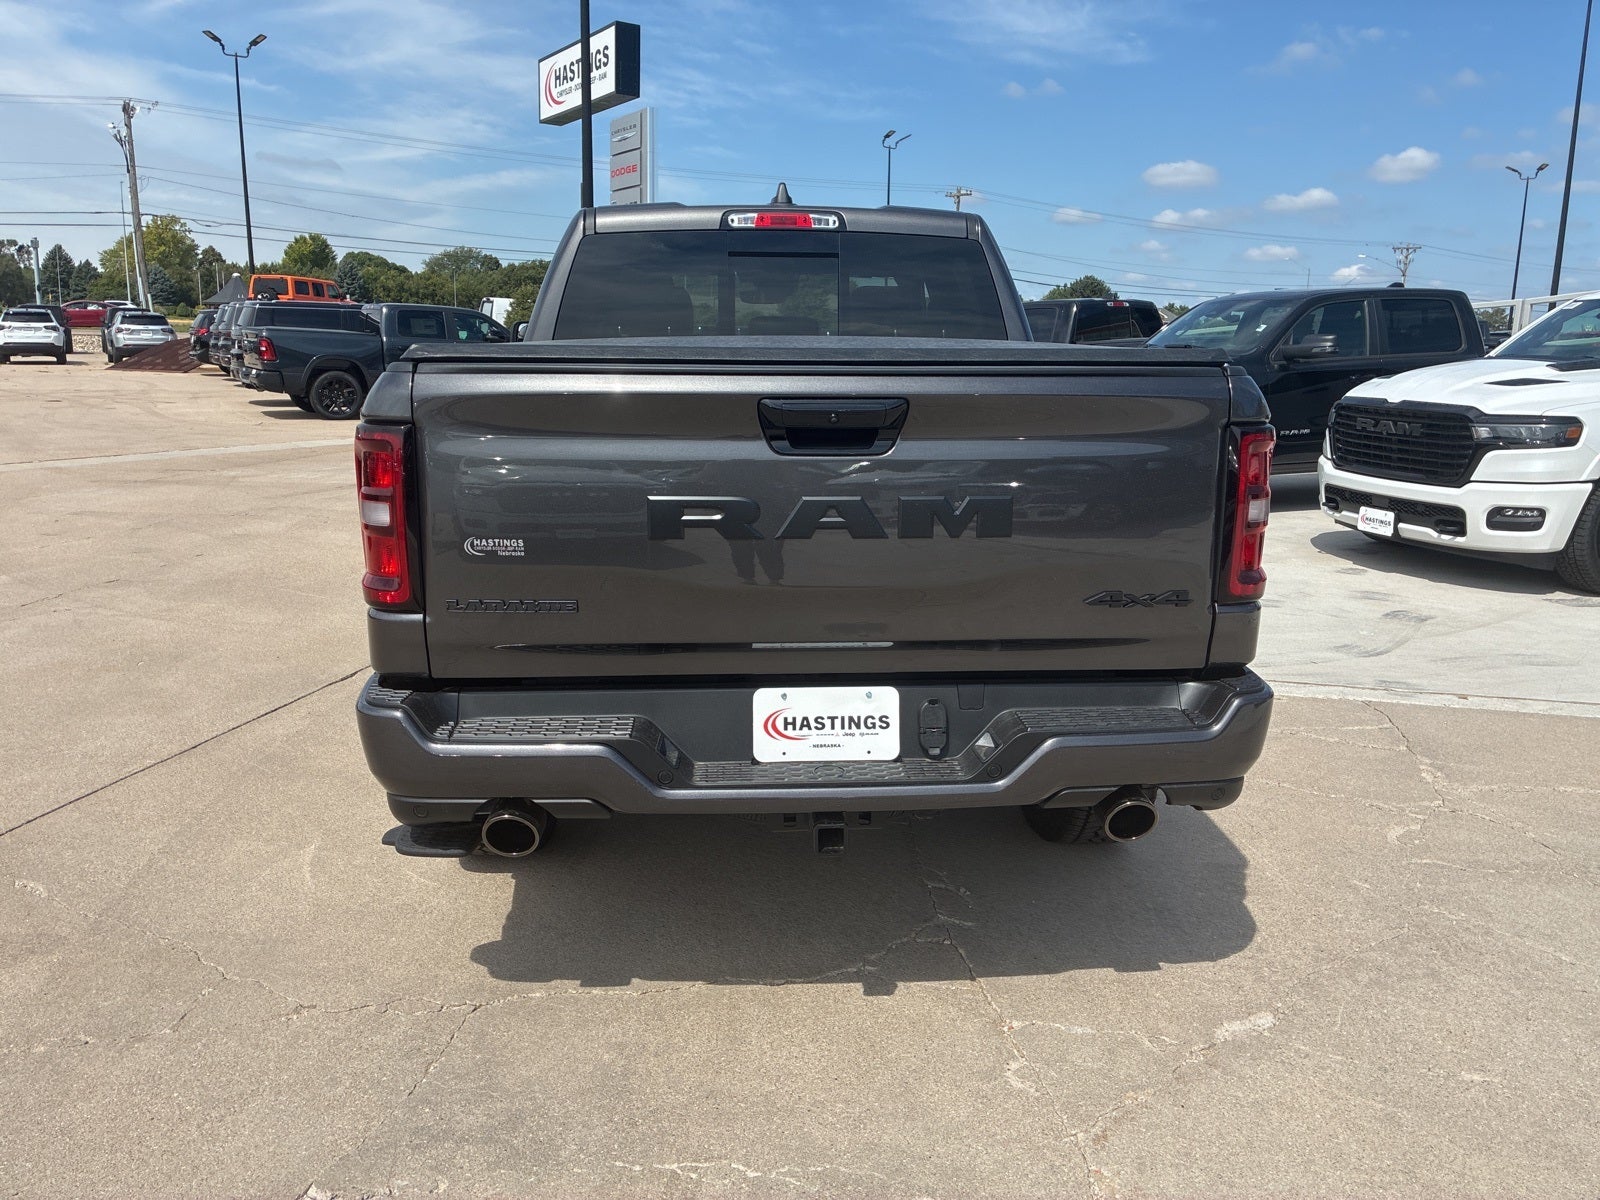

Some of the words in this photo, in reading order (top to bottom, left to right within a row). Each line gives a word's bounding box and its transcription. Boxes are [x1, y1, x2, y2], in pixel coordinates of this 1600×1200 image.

[554, 45, 609, 89] HASTGS
[611, 124, 637, 136] CHRYSLER
[611, 164, 638, 180] DODGE
[1356, 417, 1422, 436] RAM
[647, 496, 1013, 539] RAM
[1365, 516, 1392, 527] HASTINGS
[473, 538, 524, 547] HASTINGS
[445, 599, 579, 613] LARAMIE
[783, 715, 891, 731] HASTINGS
